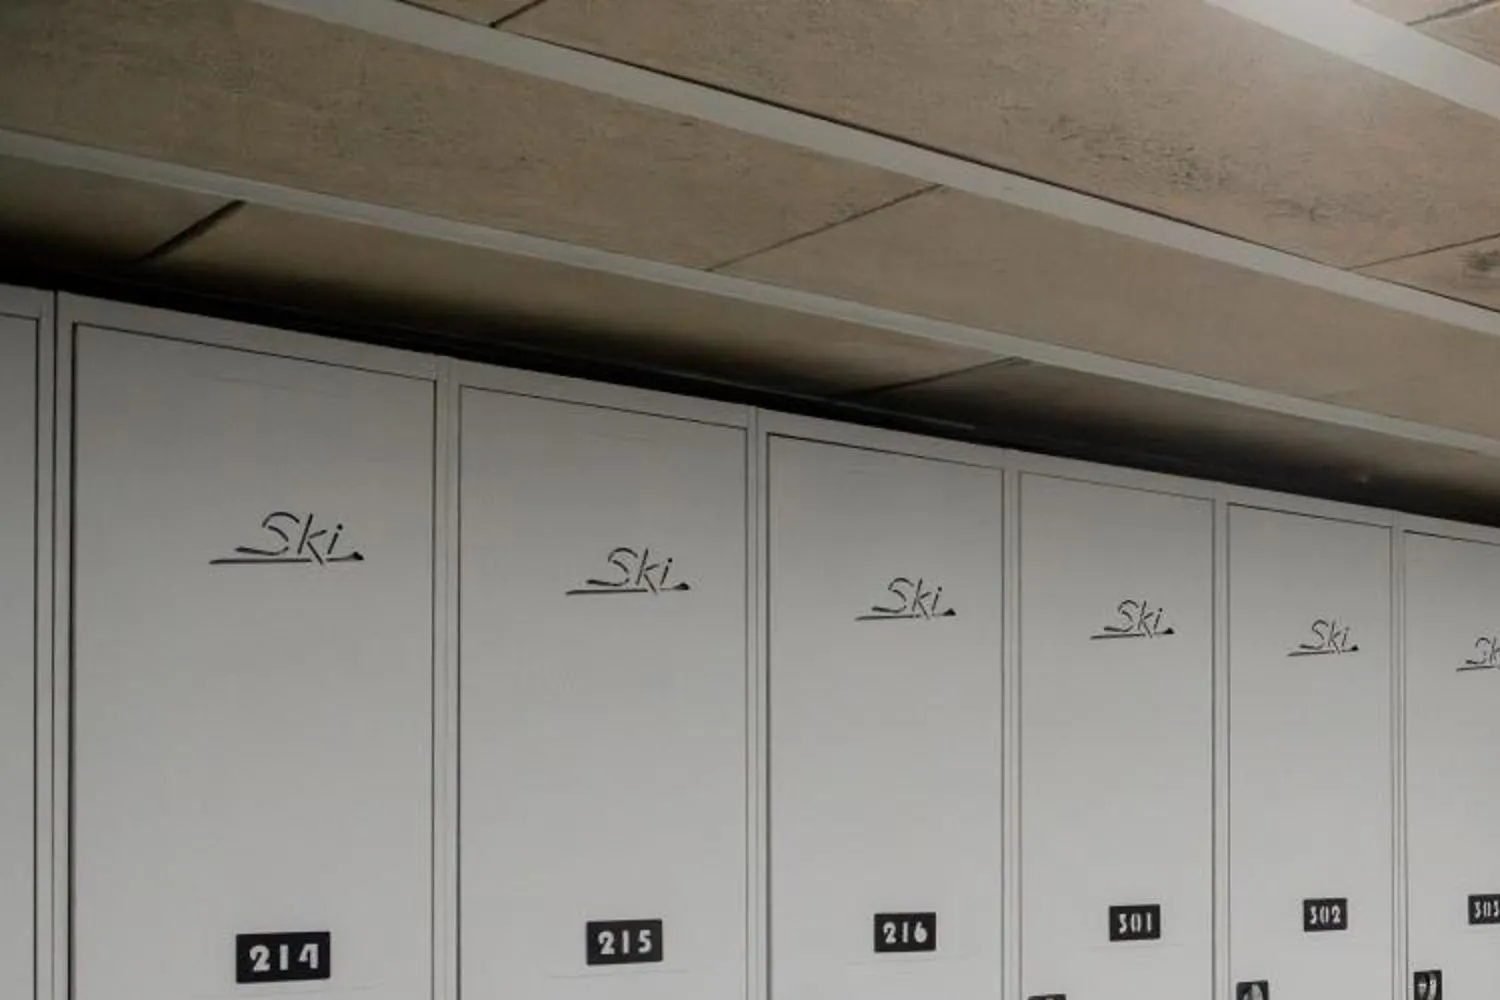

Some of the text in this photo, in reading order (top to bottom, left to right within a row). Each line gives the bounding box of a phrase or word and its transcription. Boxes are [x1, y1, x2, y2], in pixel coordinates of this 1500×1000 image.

[235, 511, 344, 565] Ski
[587, 548, 673, 594] Ski
[871, 578, 943, 619] Ski
[1104, 600, 1163, 637] Ski
[1299, 619, 1350, 654] Ski
[1118, 912, 1152, 934] 301
[1310, 905, 1341, 924] 302
[1474, 900, 1500, 919] 303
[597, 929, 652, 955] 215
[883, 921, 928, 944] 216
[249, 944, 319, 971] 214
